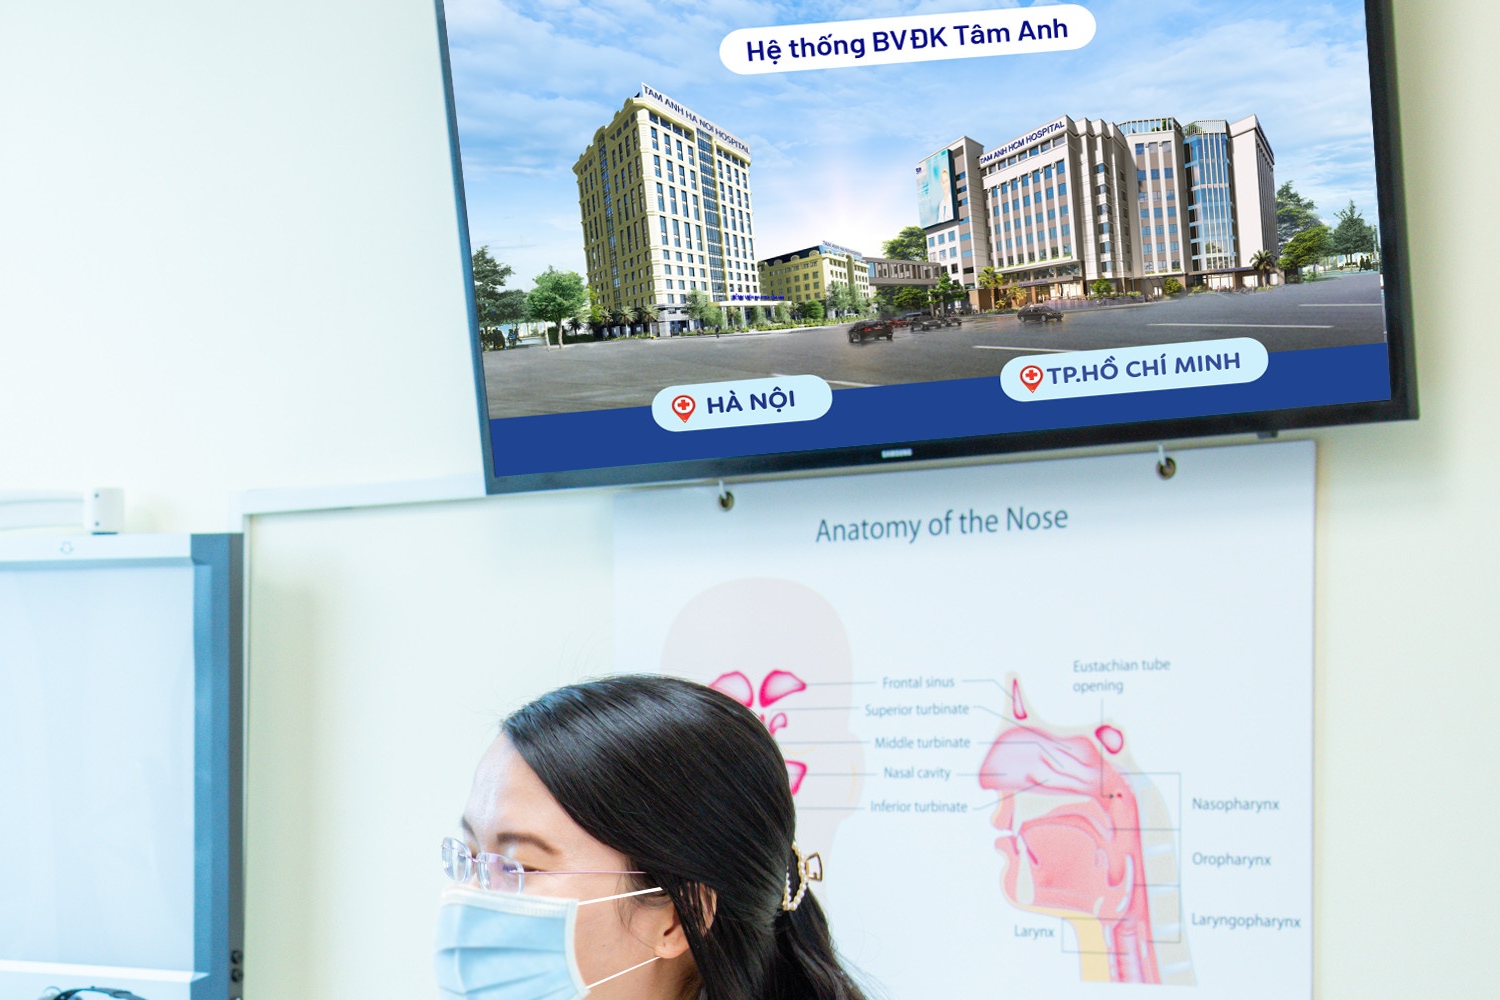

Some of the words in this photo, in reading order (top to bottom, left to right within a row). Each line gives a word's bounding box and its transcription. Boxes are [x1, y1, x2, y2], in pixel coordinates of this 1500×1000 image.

[747, 40, 782, 65] Hệ
[789, 33, 866, 59] thống
[872, 27, 948, 53] BVĐK
[954, 24, 1011, 46] Tâm
[1018, 18, 1069, 42] Anh
[642, 84, 664, 103] TAM
[665, 98, 685, 116] ANH
[685, 110, 699, 124] HA
[715, 127, 751, 155] HOSPITAL
[980, 154, 993, 164] TAM
[993, 146, 1008, 160] ANH
[1008, 139, 1025, 153] HCM
[1025, 120, 1066, 145] HOSPITAL
[1047, 354, 1120, 386] TP.HỒ
[1125, 354, 1168, 381] CHÍ
[1175, 352, 1241, 375] MINH
[707, 393, 744, 415] HÀ
[750, 389, 796, 416] NỘI
[815, 518, 922, 545] Anatomy
[928, 509, 954, 537] of
[959, 508, 999, 535] the
[1006, 506, 1069, 532] Nose
[1072, 658, 1139, 673] Eustachian
[1141, 657, 1171, 671] tube
[882, 676, 923, 689] Frontal
[925, 675, 955, 689] sinus
[1072, 679, 1124, 695] opening
[865, 704, 913, 718] Superior
[916, 702, 970, 716] turbinate
[874, 736, 914, 749] Middle
[917, 736, 971, 749] turbinate
[883, 766, 915, 779] Nasal
[917, 766, 952, 782] cavity
[870, 799, 912, 813] Inferior
[914, 799, 968, 813] turbinate
[1192, 797, 1280, 812] Nasopharynx
[1192, 851, 1271, 867] Oropharynx
[1191, 913, 1301, 930] Laryngopharynx
[1014, 924, 1055, 940] Larynx
